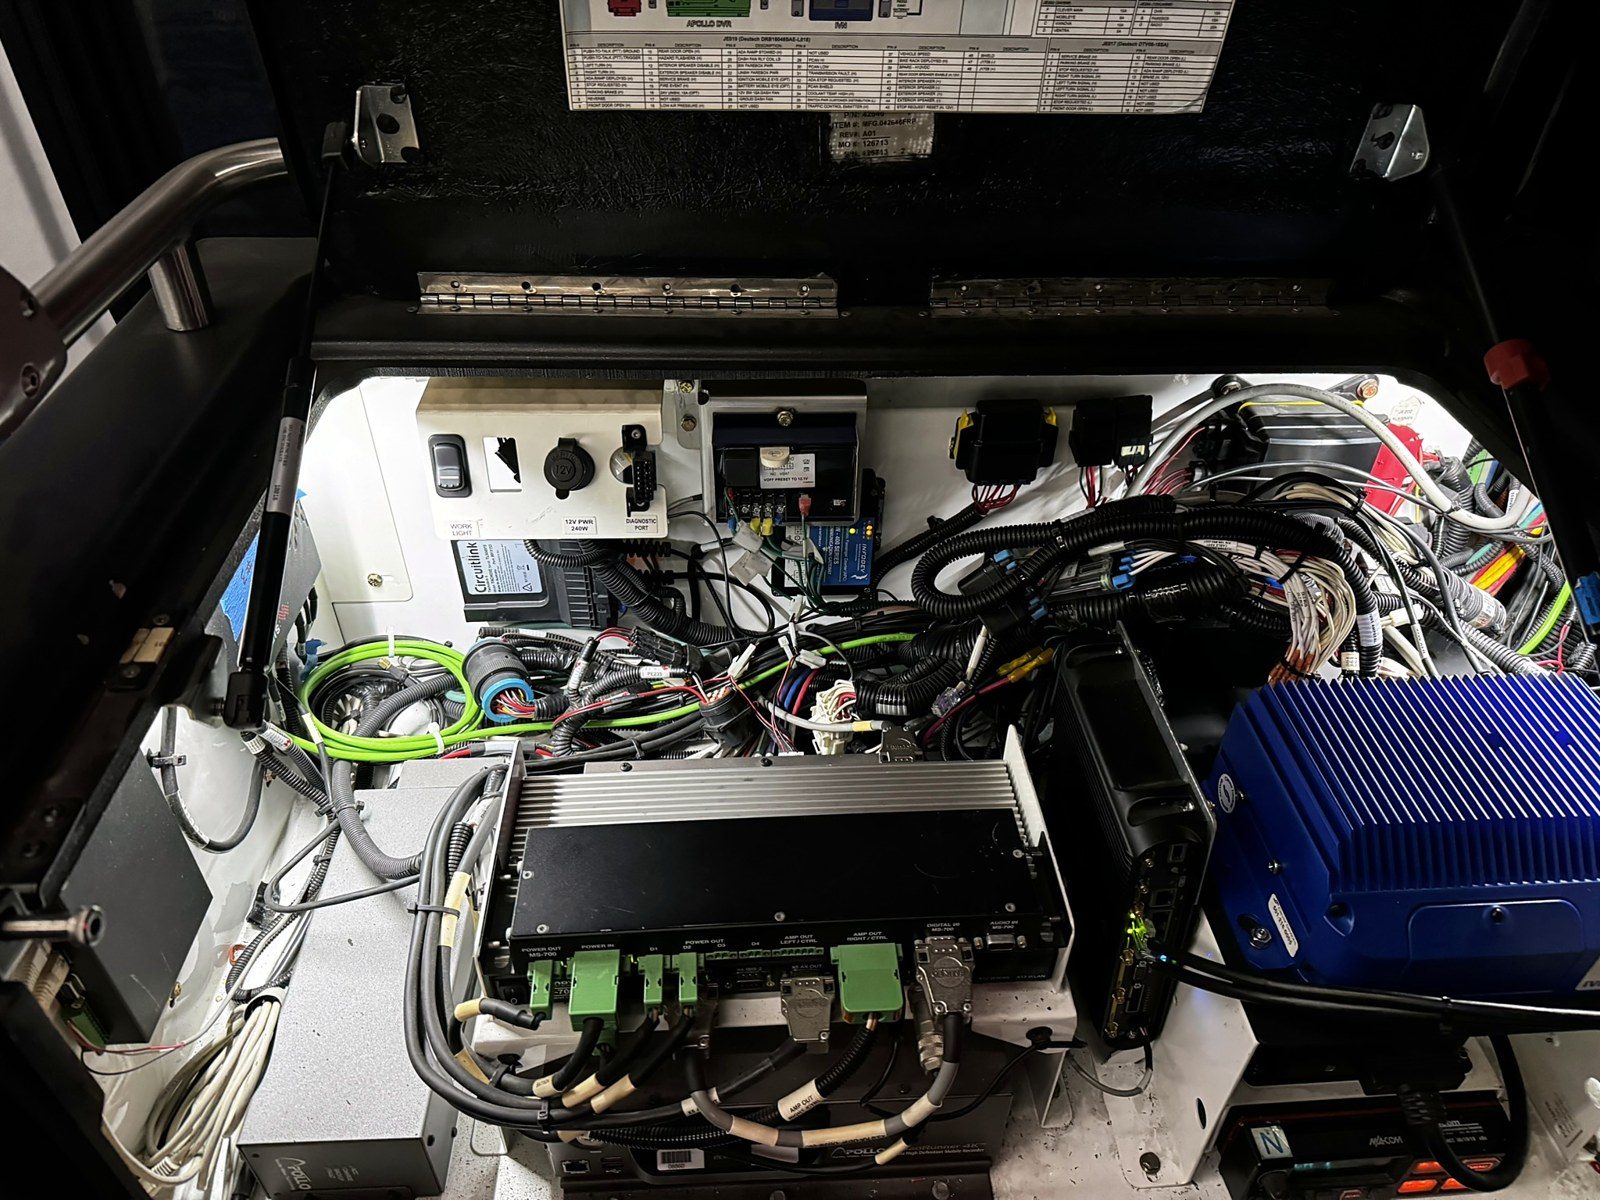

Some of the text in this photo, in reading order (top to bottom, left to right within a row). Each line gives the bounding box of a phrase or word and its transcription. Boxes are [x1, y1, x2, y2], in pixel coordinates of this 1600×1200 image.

[716, 20, 732, 28] DVR
[862, 139, 888, 149] 126713
[556, 465, 572, 474] 12V
[466, 542, 487, 592] Circuitlink
[789, 1102, 802, 1114] AMP
[801, 1095, 814, 1106] OUT
[1260, 1132, 1284, 1154] N
[831, 1146, 886, 1157] APOLLO
[280, 1157, 312, 1190] APOLLO
